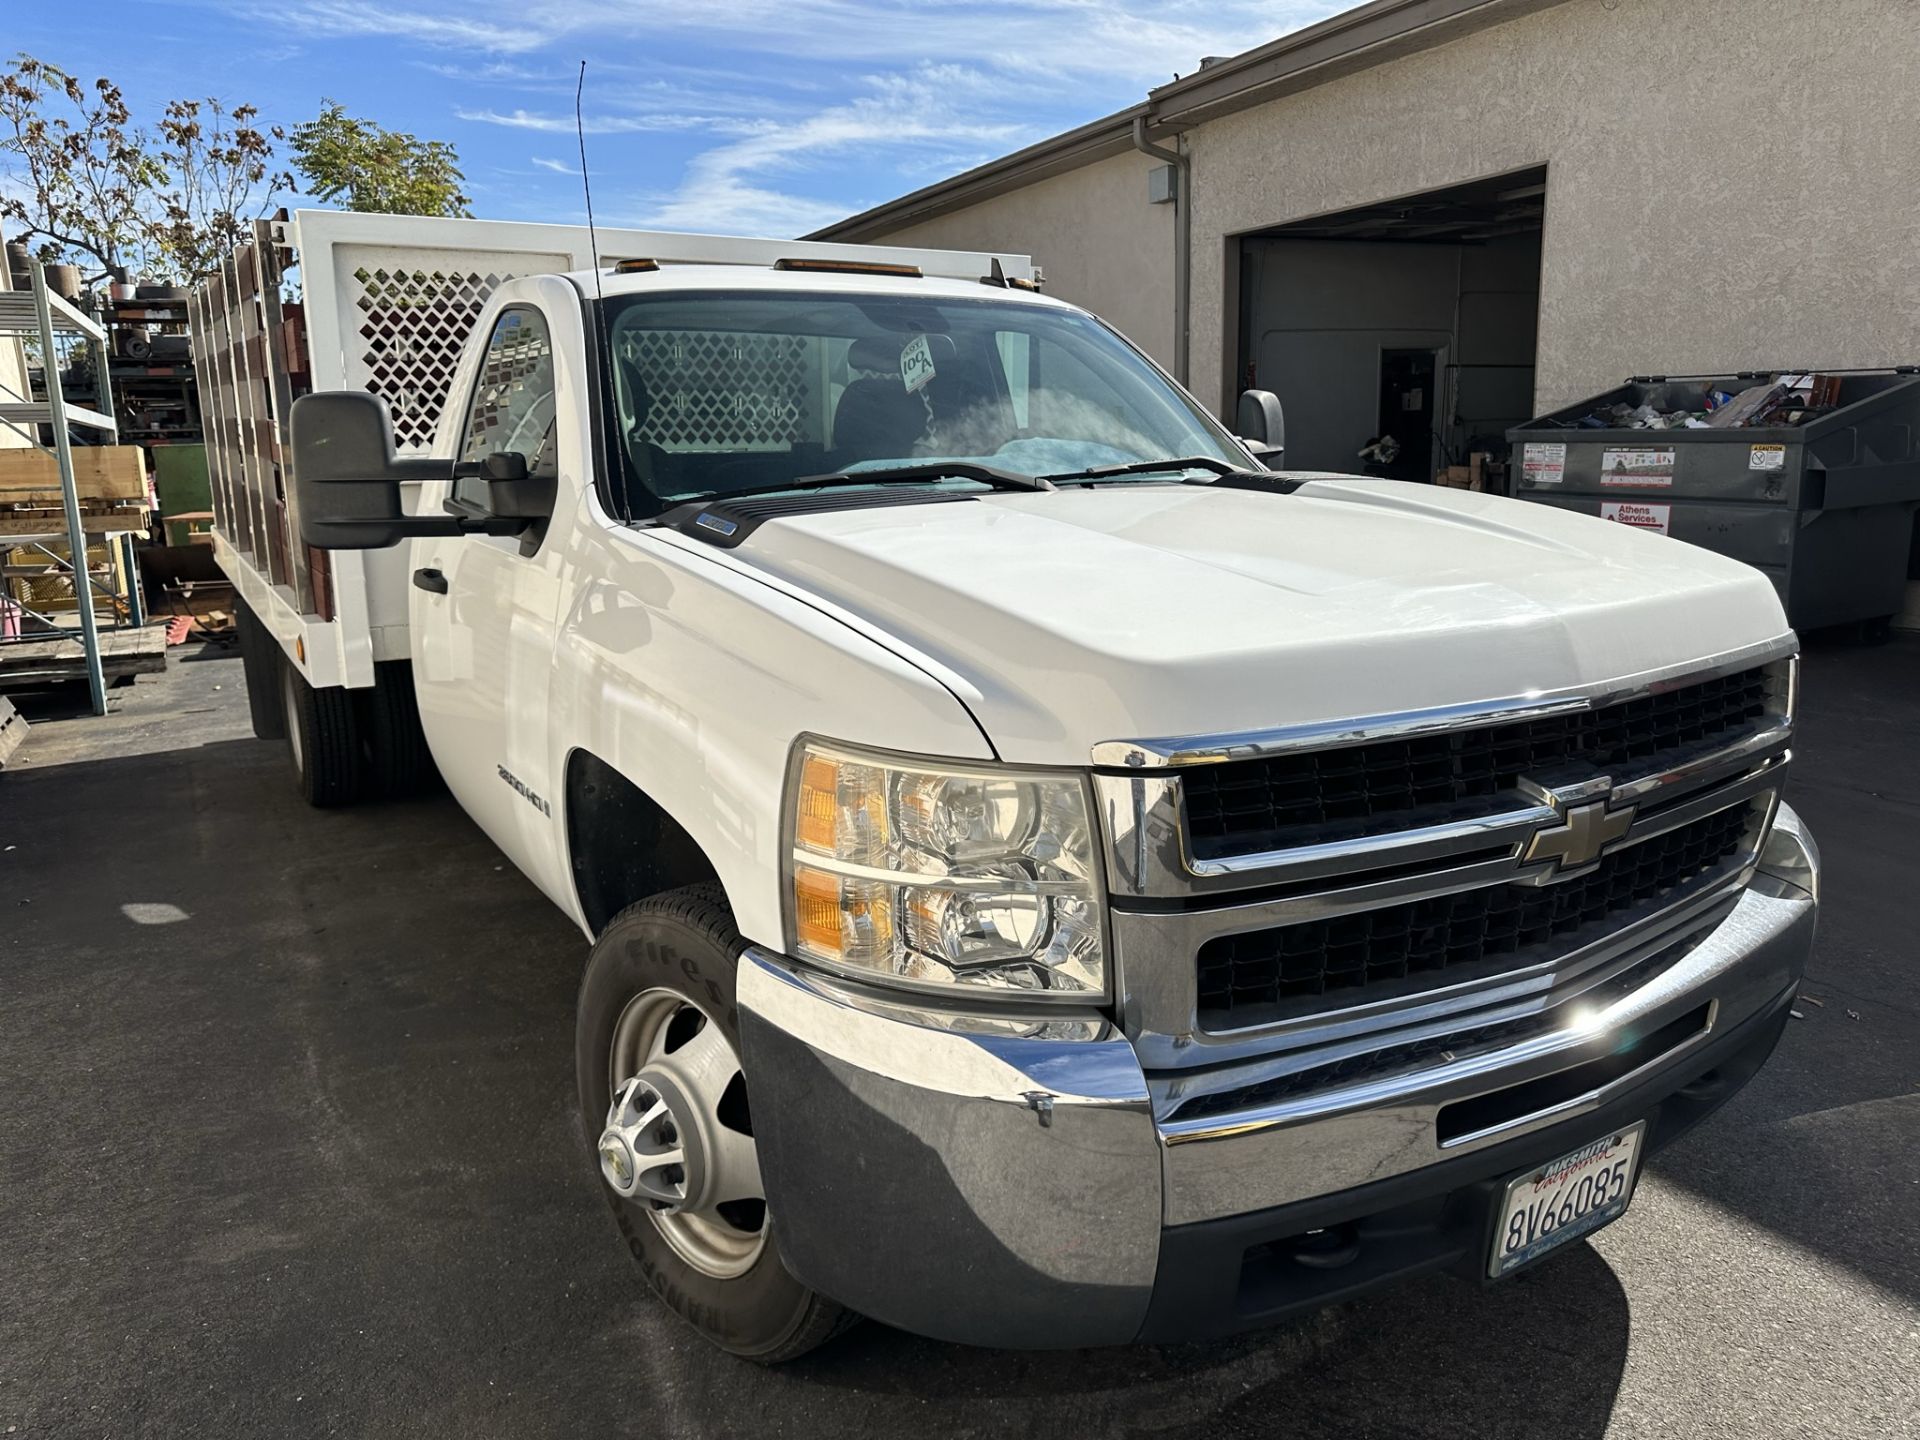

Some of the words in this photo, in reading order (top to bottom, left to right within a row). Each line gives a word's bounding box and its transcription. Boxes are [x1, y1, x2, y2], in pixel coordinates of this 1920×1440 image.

[1618, 505, 1650, 515] Athens
[1618, 513, 1656, 523] Services
[1505, 1158, 1628, 1253] 8V66085
